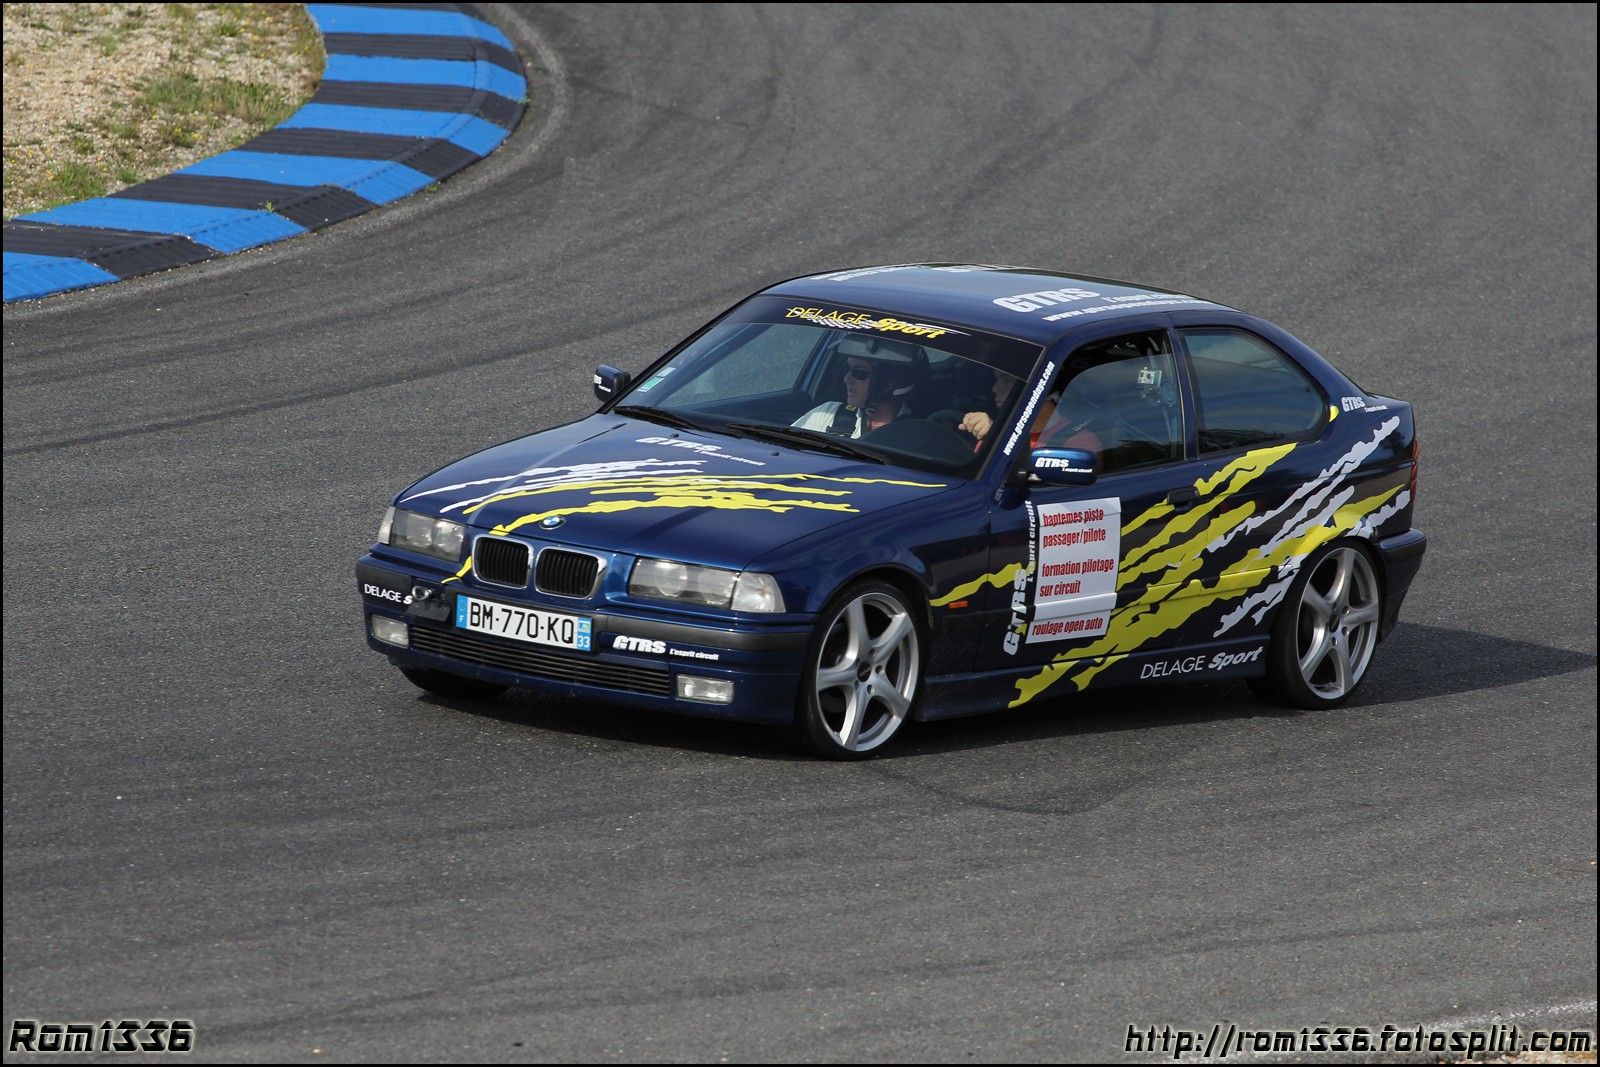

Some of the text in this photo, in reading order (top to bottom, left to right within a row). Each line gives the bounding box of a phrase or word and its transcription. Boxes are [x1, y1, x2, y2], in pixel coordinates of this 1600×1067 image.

[993, 288, 1100, 313] GTRS
[785, 307, 945, 339] DELAGE Sport
[1003, 361, 1055, 456] www.gtrsopendays.com
[1341, 396, 1366, 412] GTRS
[635, 437, 722, 451] GTRS
[1035, 457, 1069, 468] GTRS
[1024, 500, 1036, 538] circuit
[1043, 508, 1104, 527] baptemes piste
[1043, 528, 1106, 549] passager/pilote
[1042, 559, 1114, 577] formation pilotage
[364, 584, 402, 603] DELAGE
[1040, 580, 1081, 597] sur circuit
[1003, 568, 1027, 655] GTRS
[1032, 617, 1104, 636] roulage open auto
[577, 635, 590, 648] 33
[612, 635, 667, 654] GTRS
[1140, 646, 1263, 679] DELAGE Sport
